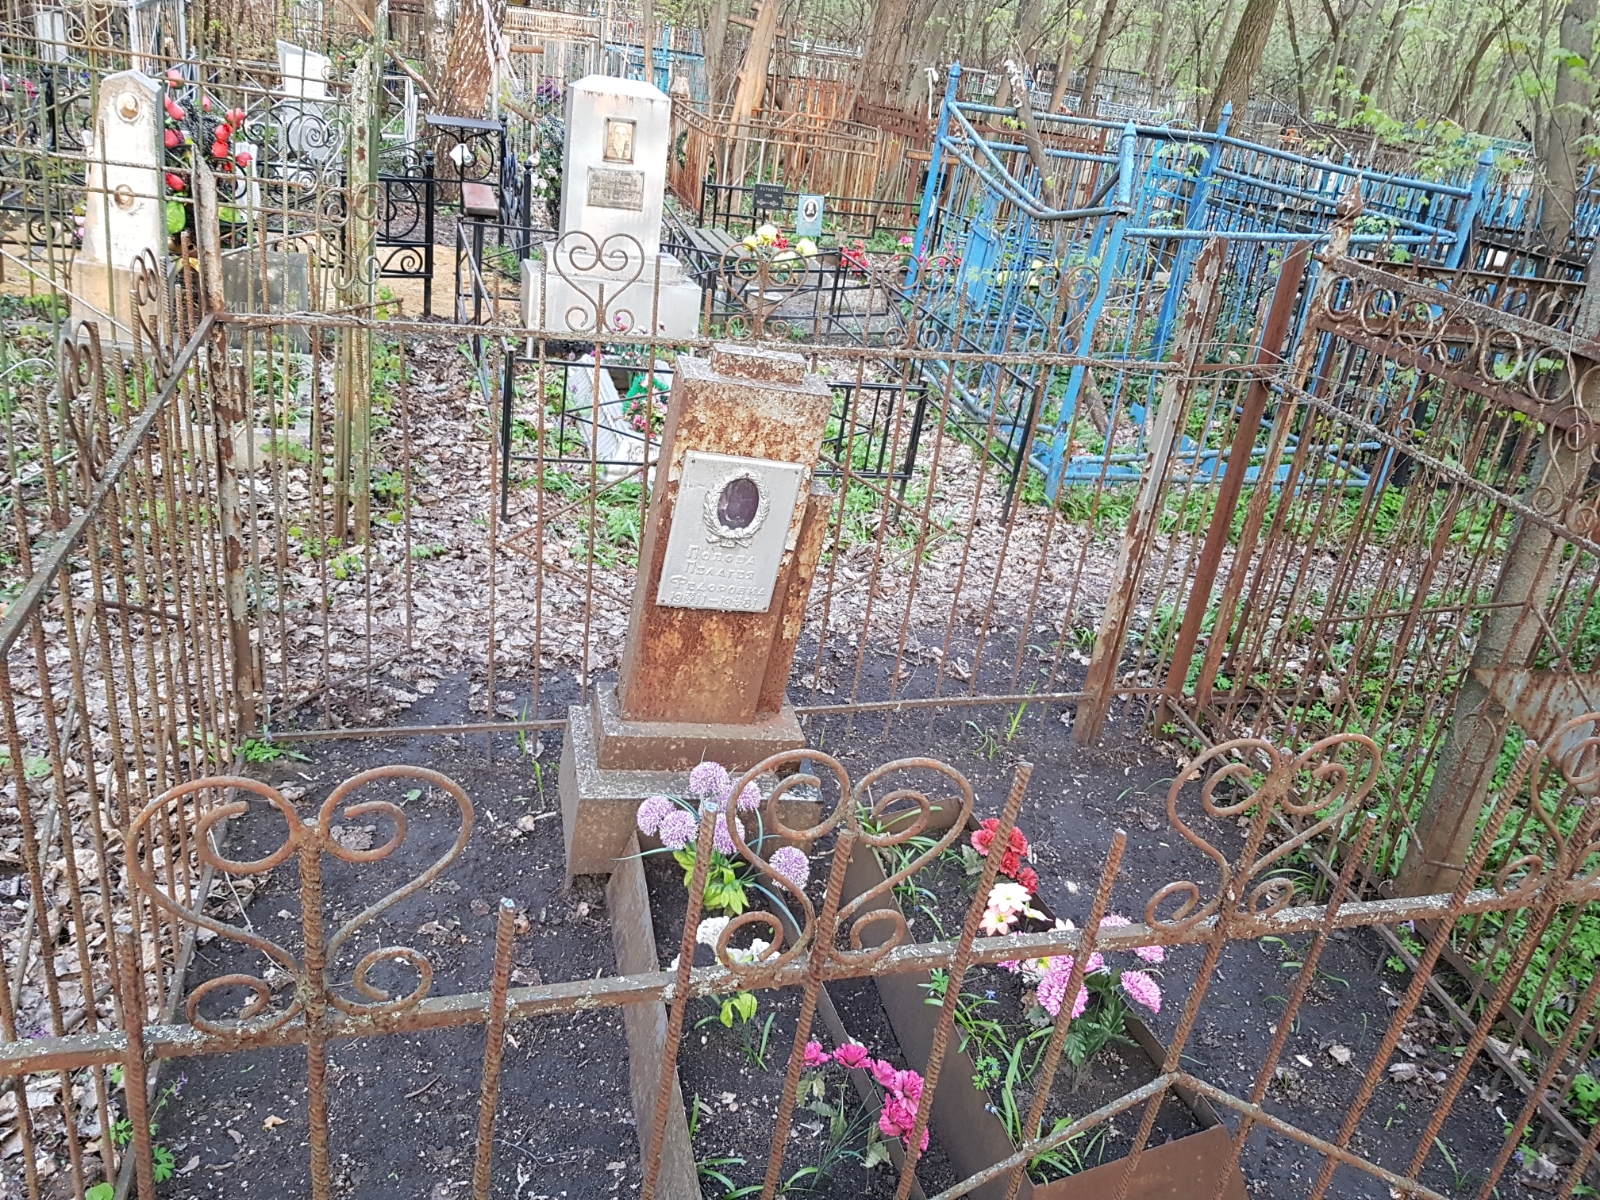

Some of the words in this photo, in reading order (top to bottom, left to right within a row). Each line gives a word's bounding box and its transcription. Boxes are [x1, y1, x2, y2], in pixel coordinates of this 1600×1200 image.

[686, 544, 756, 565] ПОПОВА
[685, 559, 755, 580] ПЕЛАГЕЯ
[670, 574, 766, 597] ФЕДОРОВНА
